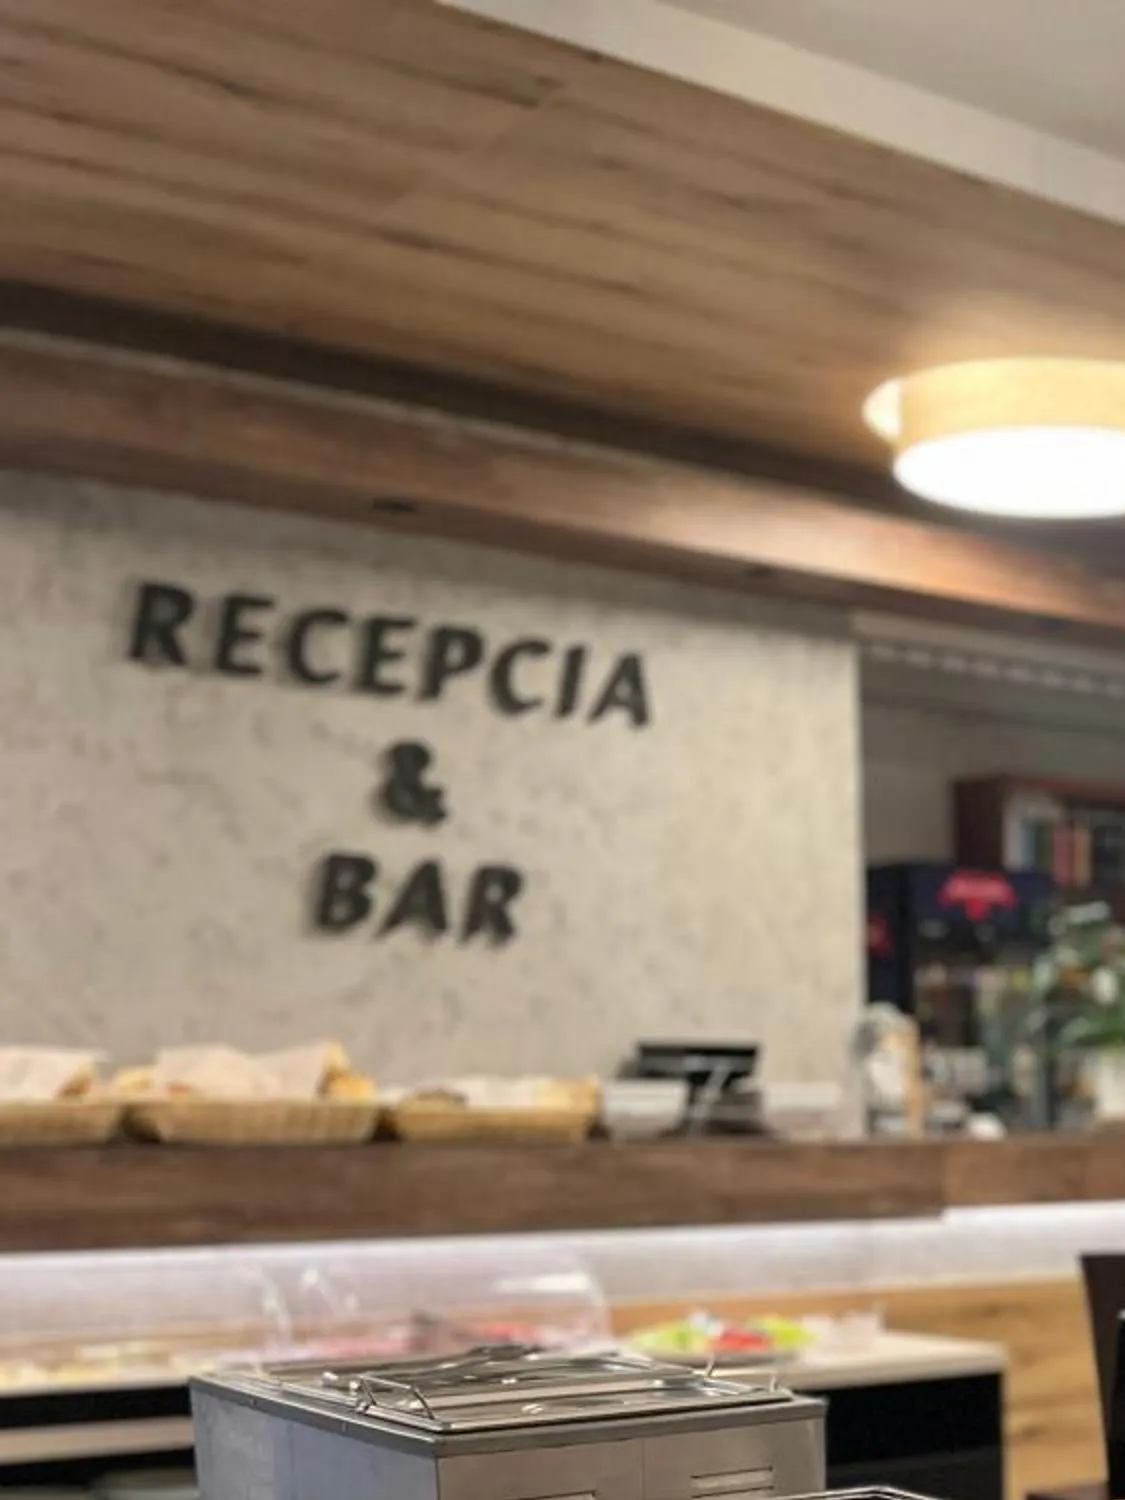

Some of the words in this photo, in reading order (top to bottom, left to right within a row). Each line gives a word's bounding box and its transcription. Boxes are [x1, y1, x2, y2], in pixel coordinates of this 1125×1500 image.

[127, 582, 650, 730] RECEPCIA
[376, 740, 448, 829] &
[313, 852, 524, 946] BAR
